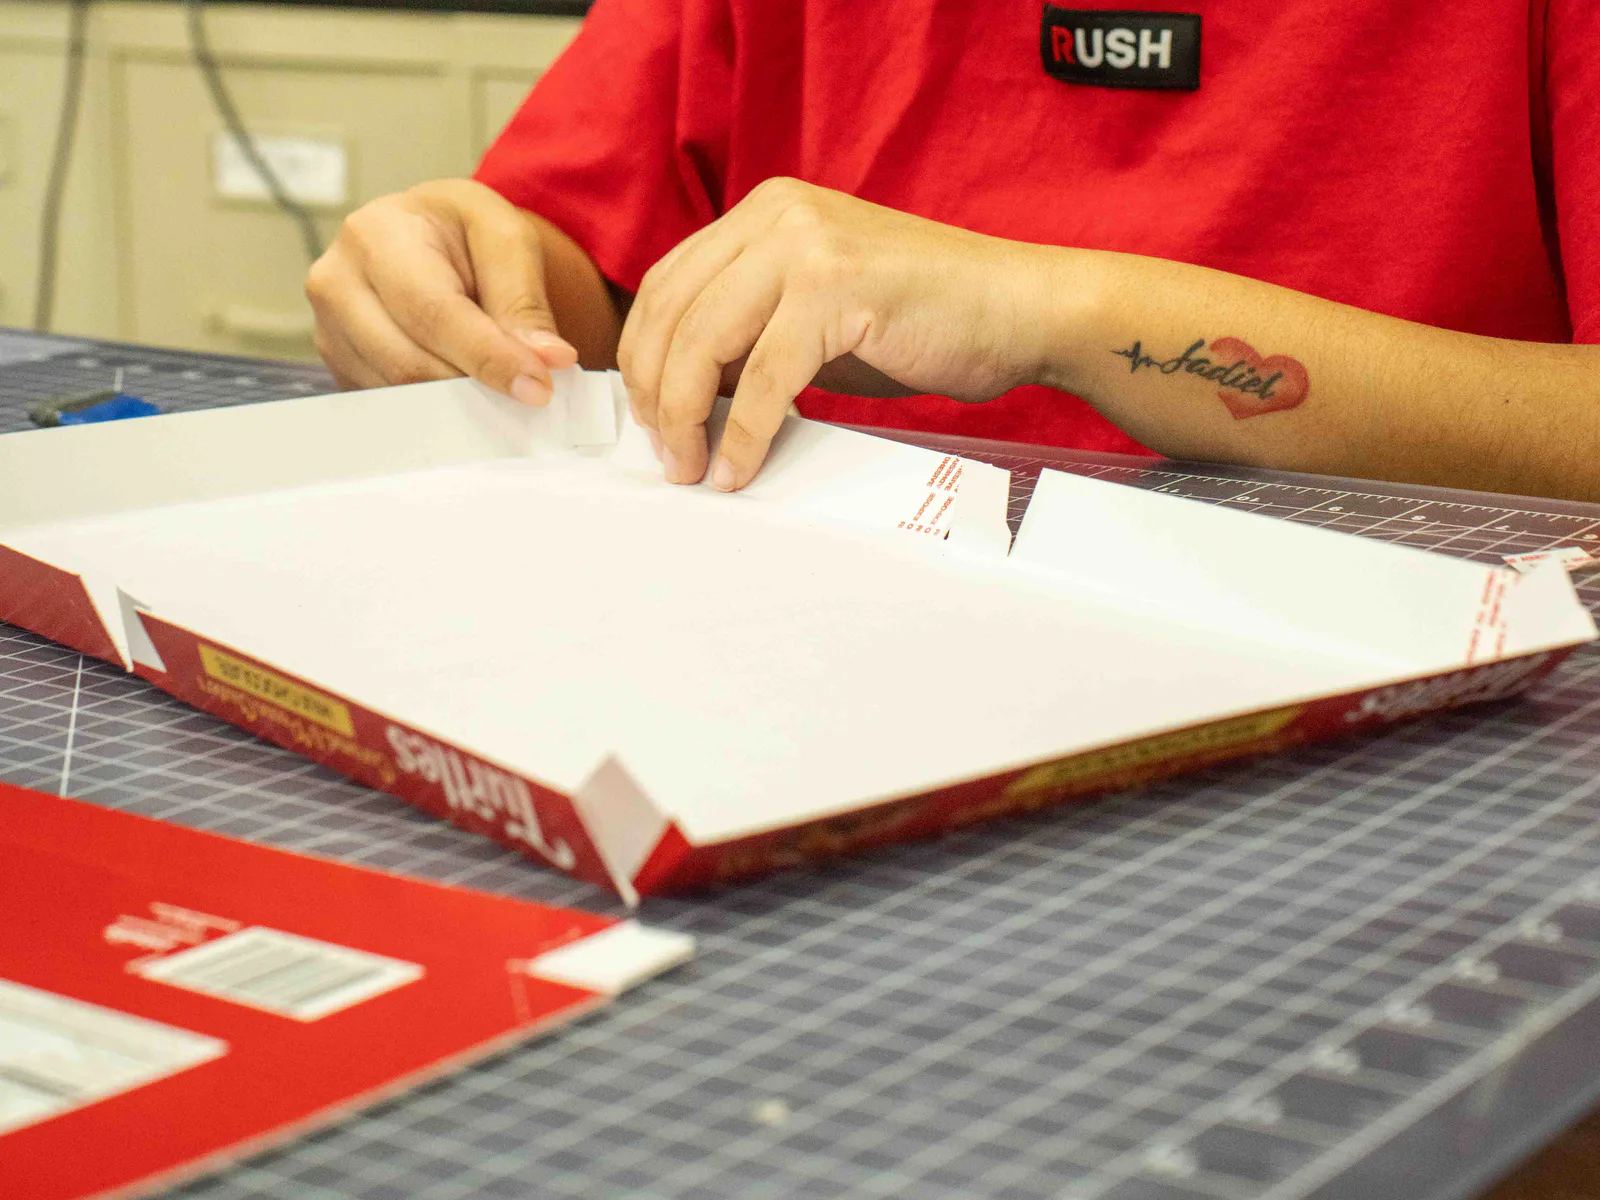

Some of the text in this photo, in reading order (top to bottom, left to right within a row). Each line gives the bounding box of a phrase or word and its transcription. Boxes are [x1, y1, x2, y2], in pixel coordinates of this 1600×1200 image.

[1051, 25, 1173, 69] RUSH
[926, 456, 951, 487] DHESIVE
[936, 457, 960, 489] ADHESIV
[385, 723, 576, 871] Turtles
